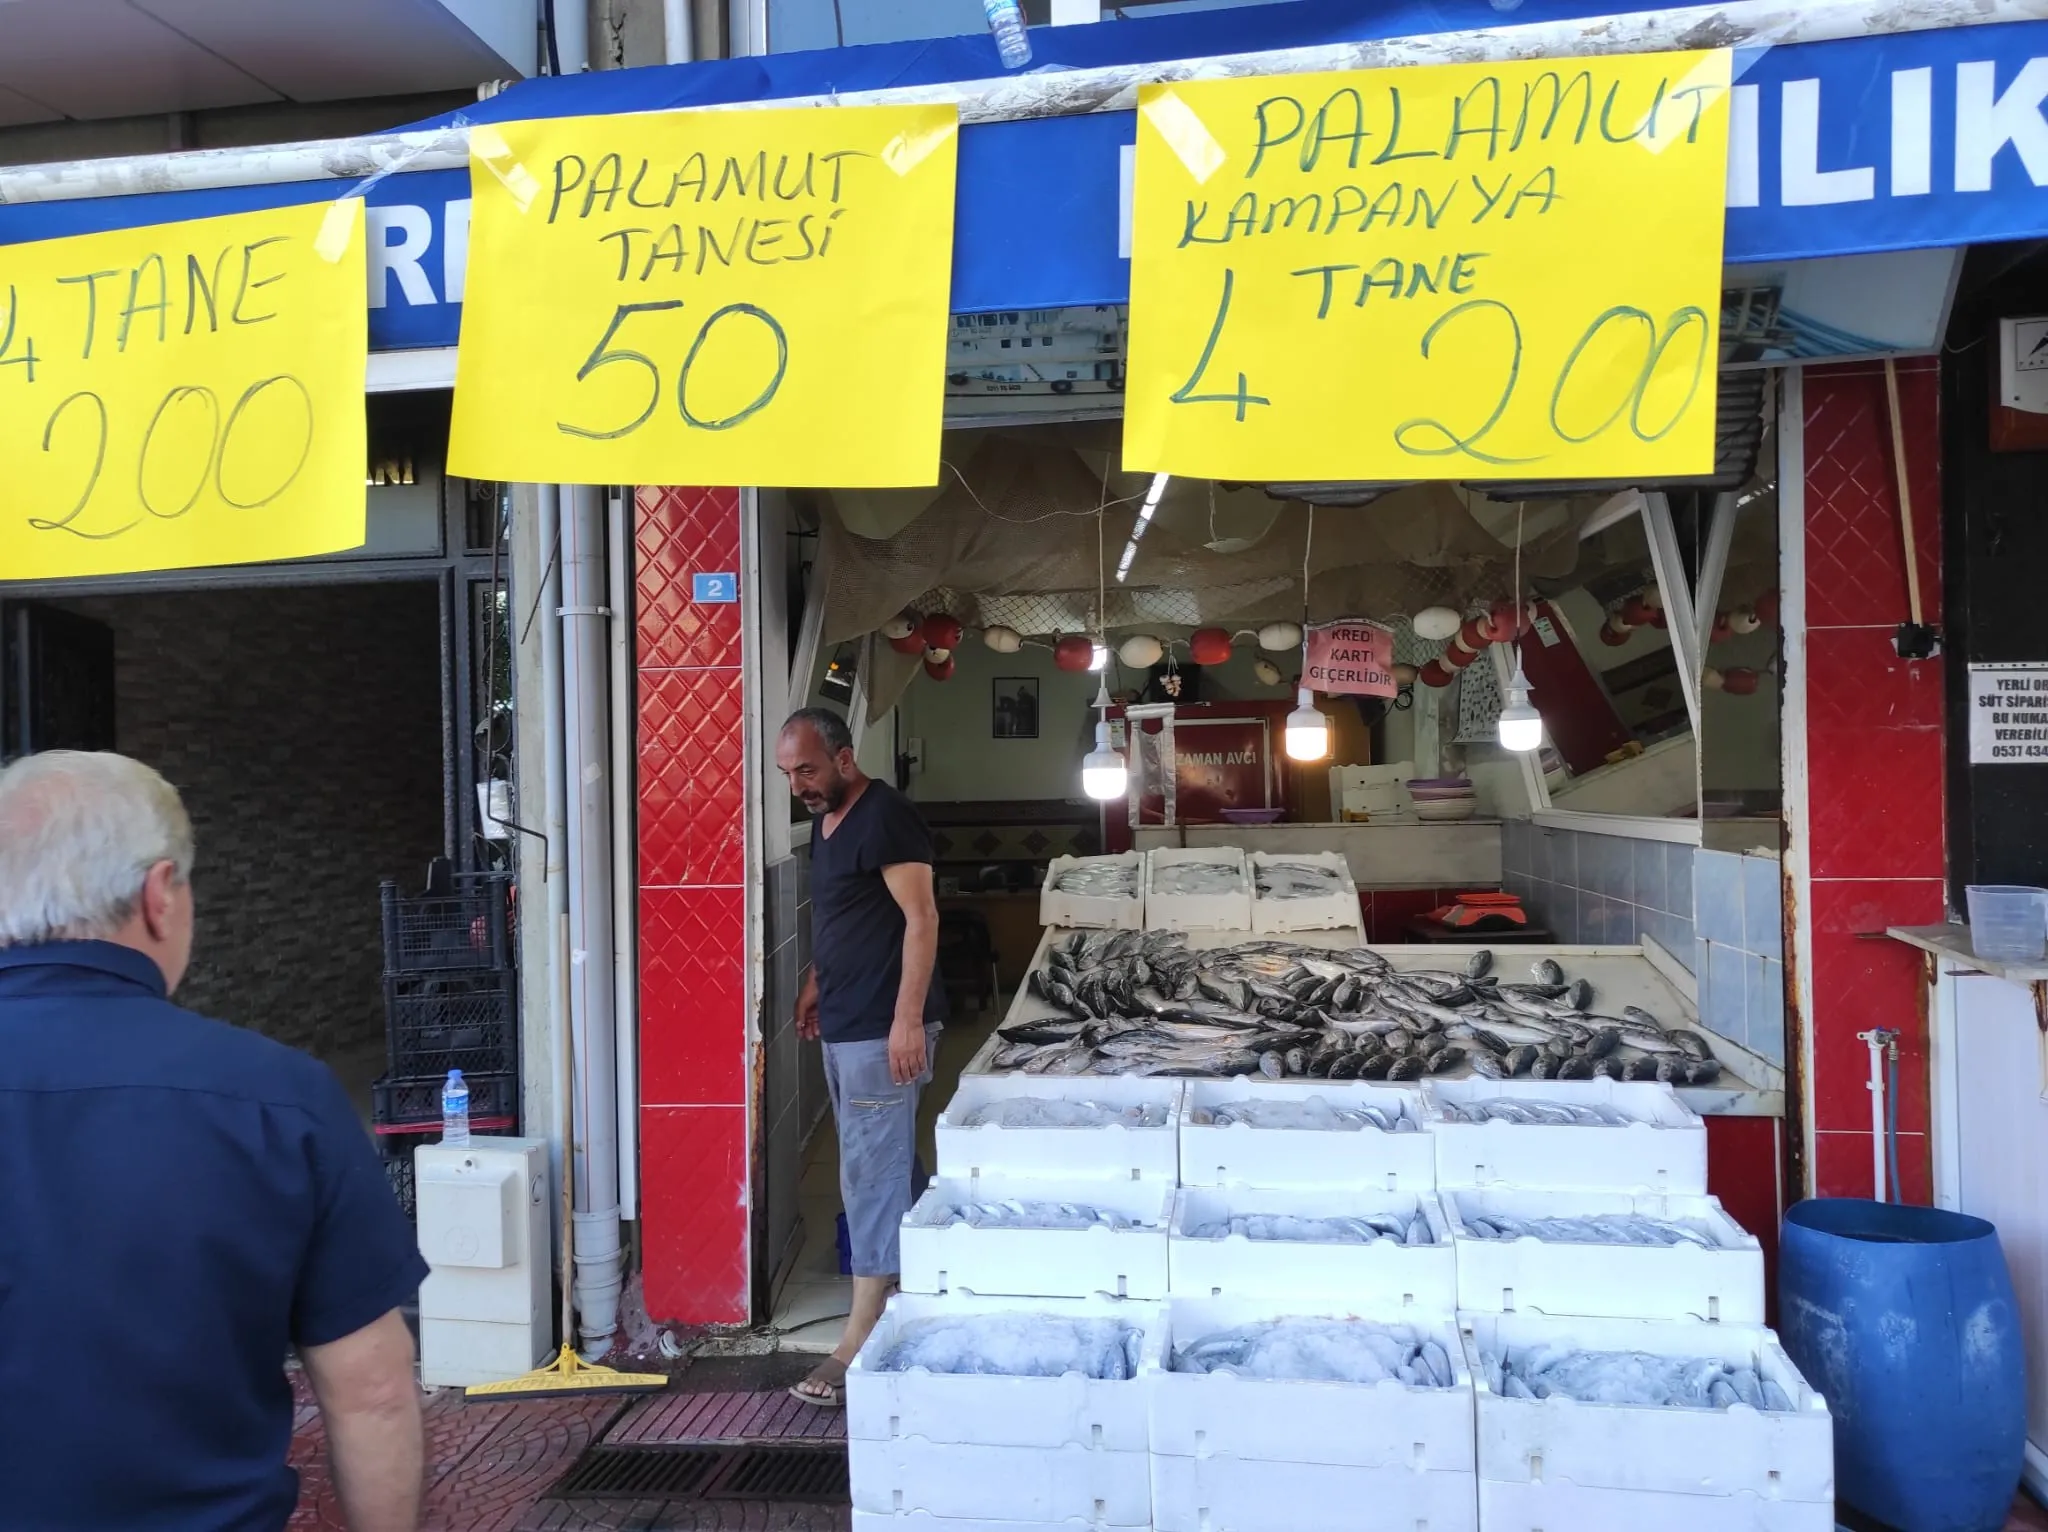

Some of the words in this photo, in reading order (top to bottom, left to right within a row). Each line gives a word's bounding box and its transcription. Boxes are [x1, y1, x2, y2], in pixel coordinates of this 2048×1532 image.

[1245, 70, 1727, 179] PALAMUT
[547, 151, 877, 224] PALAMUT
[1177, 166, 1565, 248] KAMPANYA
[598, 208, 848, 281] TANESİ
[57, 236, 295, 360] TANE
[1291, 253, 1491, 320] TANE
[556, 299, 788, 441] 50
[1169, 268, 1271, 422] 4
[1394, 298, 1709, 465] 200
[28, 373, 313, 540] 200
[707, 579, 723, 597] 2
[2006, 693, 2048, 708] SİPARİ
[1992, 745, 2022, 757] 0537
